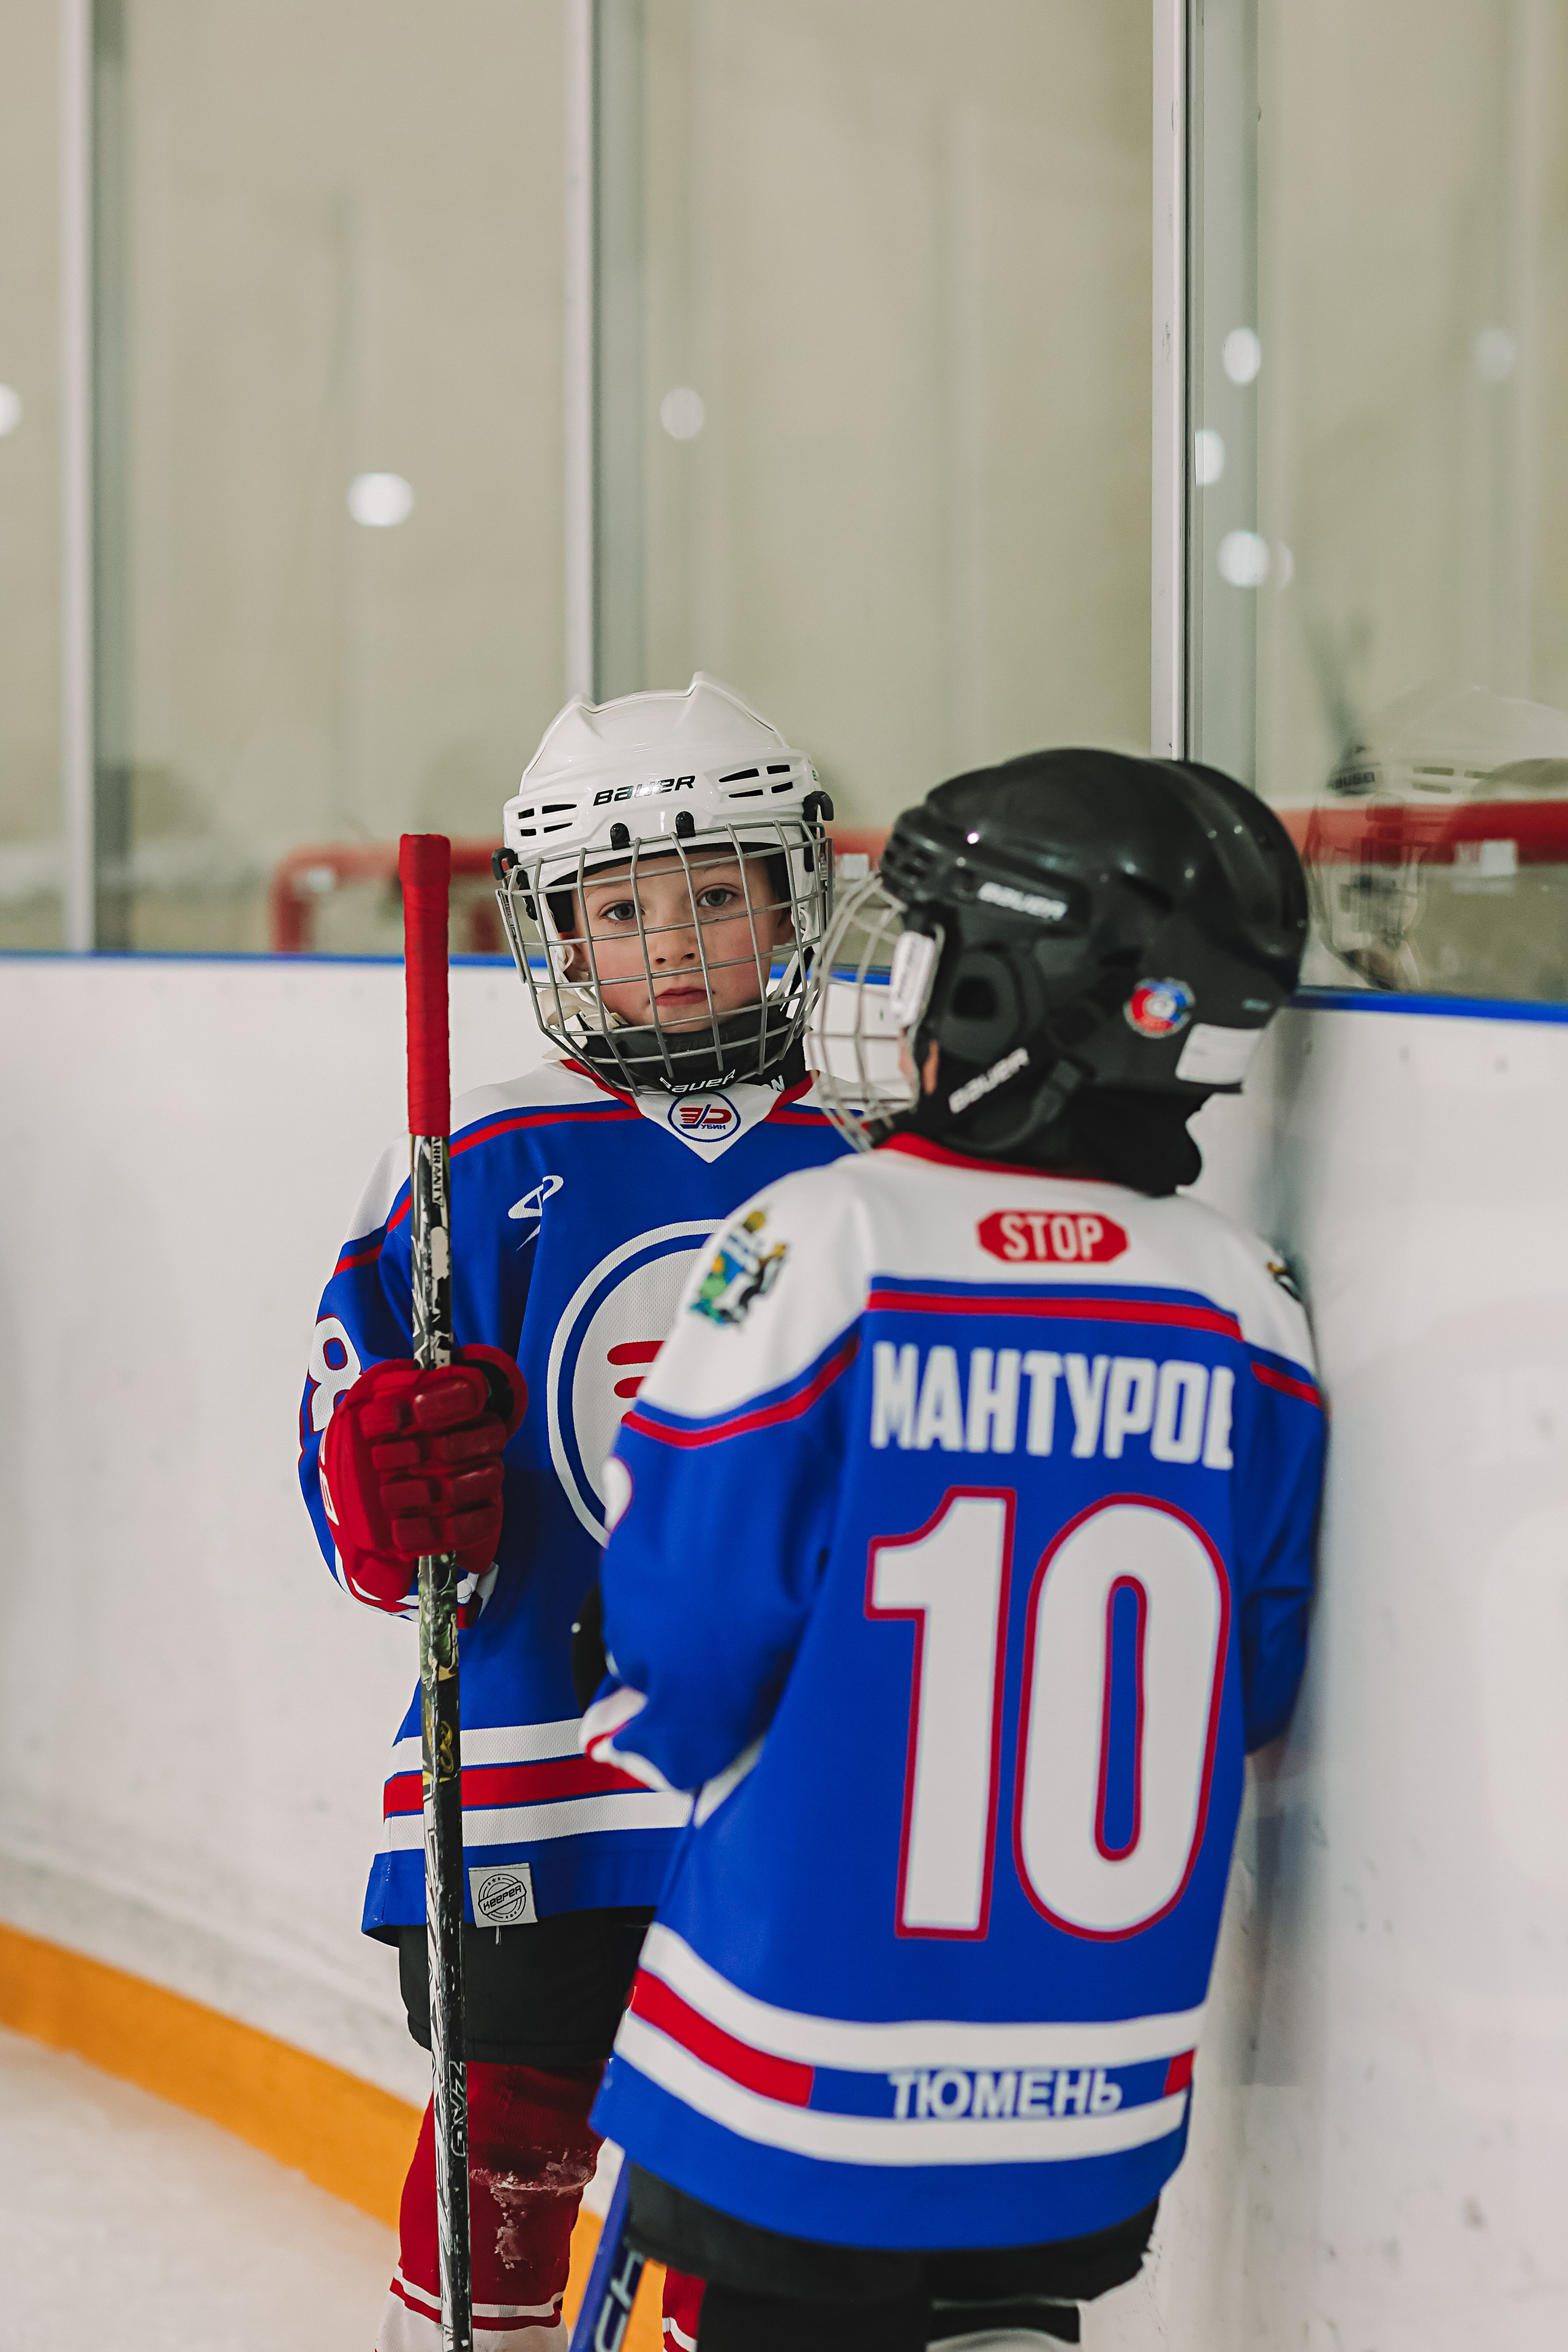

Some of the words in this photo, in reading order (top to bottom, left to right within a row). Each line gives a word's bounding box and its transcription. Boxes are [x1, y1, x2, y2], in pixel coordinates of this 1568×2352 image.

[592, 775, 696, 807] BAUER
[999, 1214, 1103, 1260] STOP
[864, 1485, 1231, 1943] 10
[483, 1885, 522, 1911] KEEPER
[888, 2069, 1123, 2119] ТЮМЕНЬ
